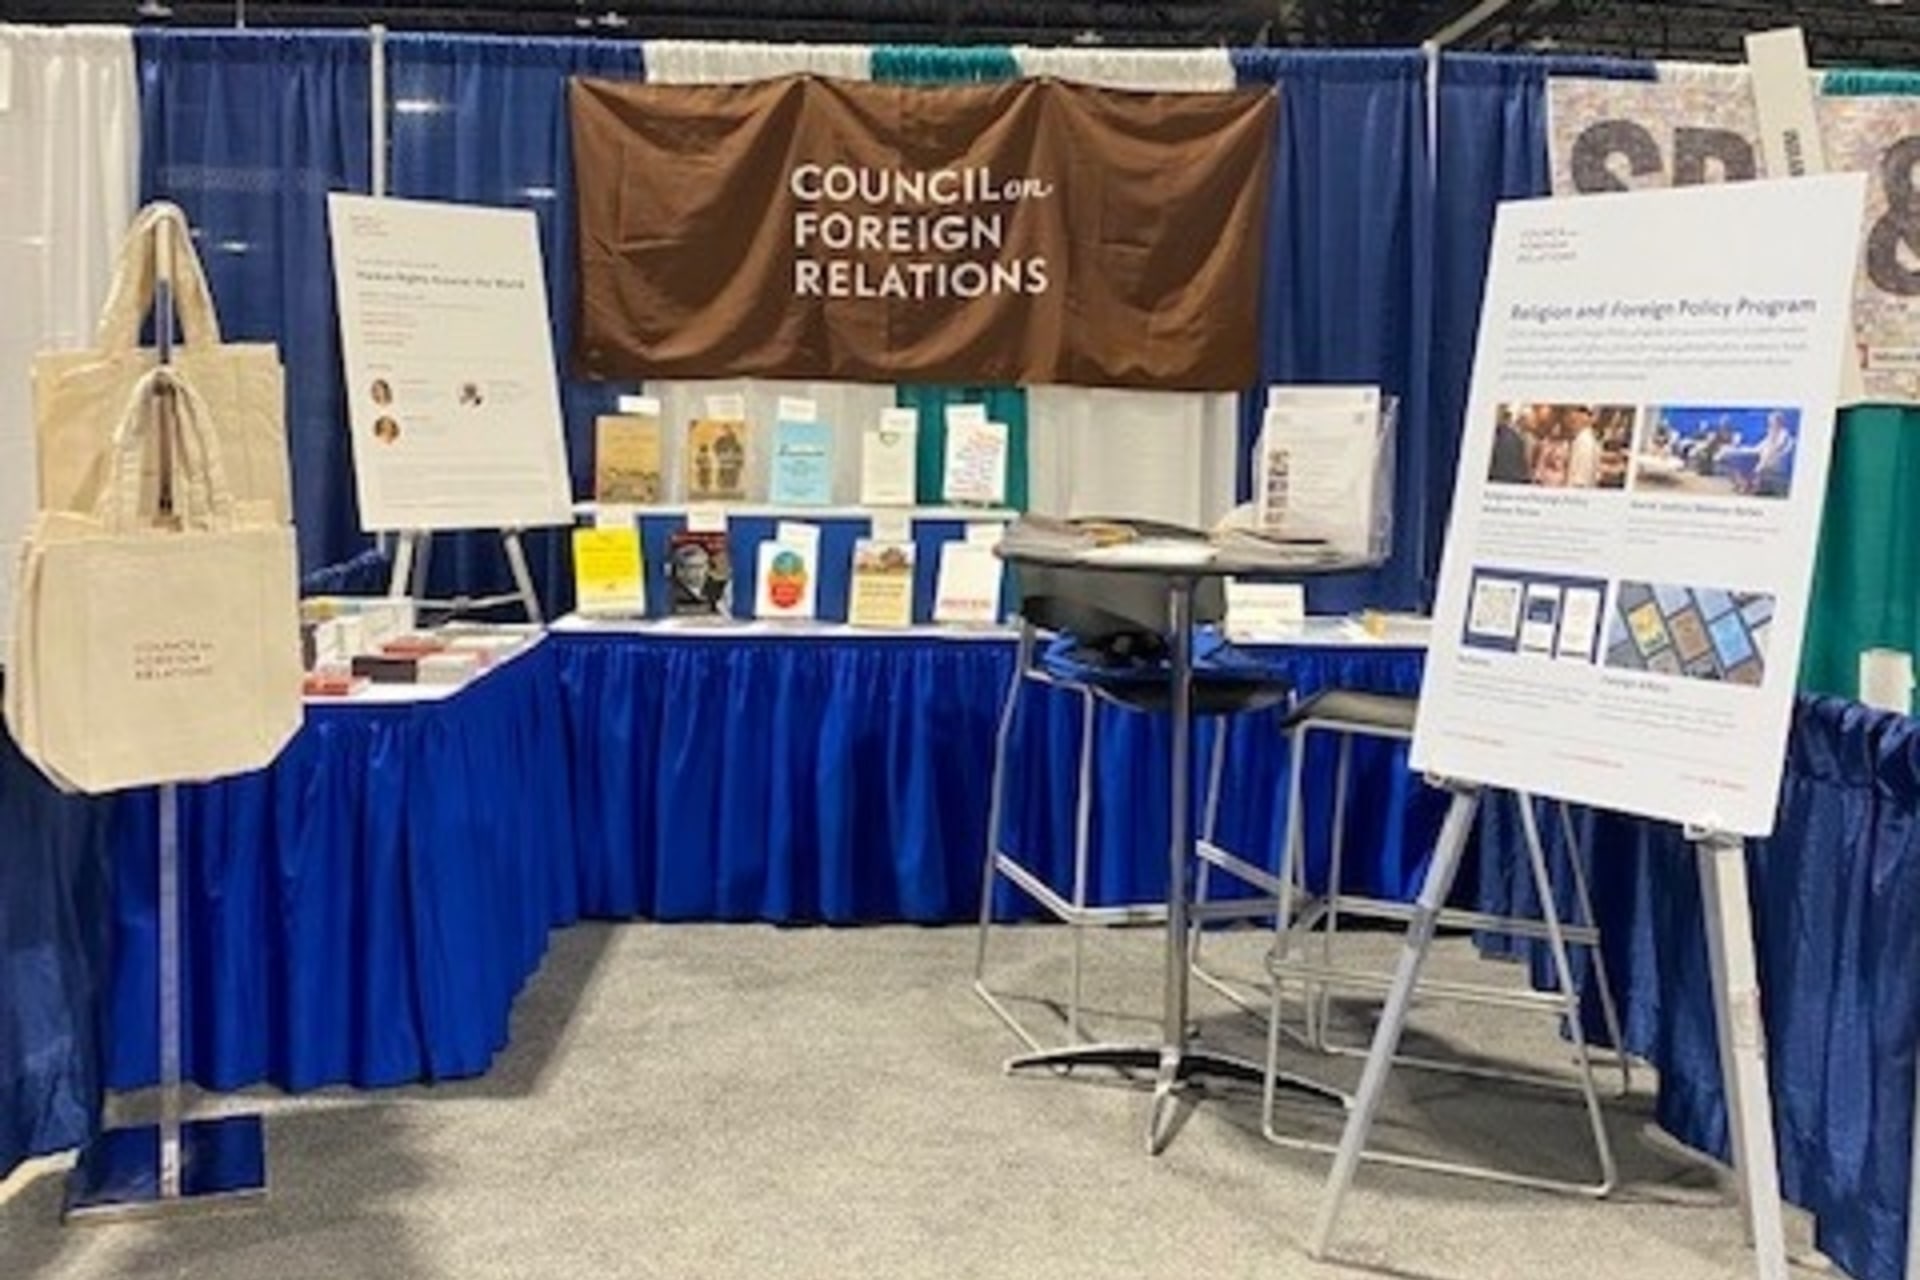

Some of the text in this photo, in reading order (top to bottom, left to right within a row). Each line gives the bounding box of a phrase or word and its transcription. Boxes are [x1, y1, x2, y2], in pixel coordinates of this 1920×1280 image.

[791, 164, 1053, 203] COUNCIL on
[795, 212, 1001, 251] FOREIGN
[795, 257, 1049, 299] RELATIONS
[1510, 297, 1817, 324] Religion and Foreign Policy Program
